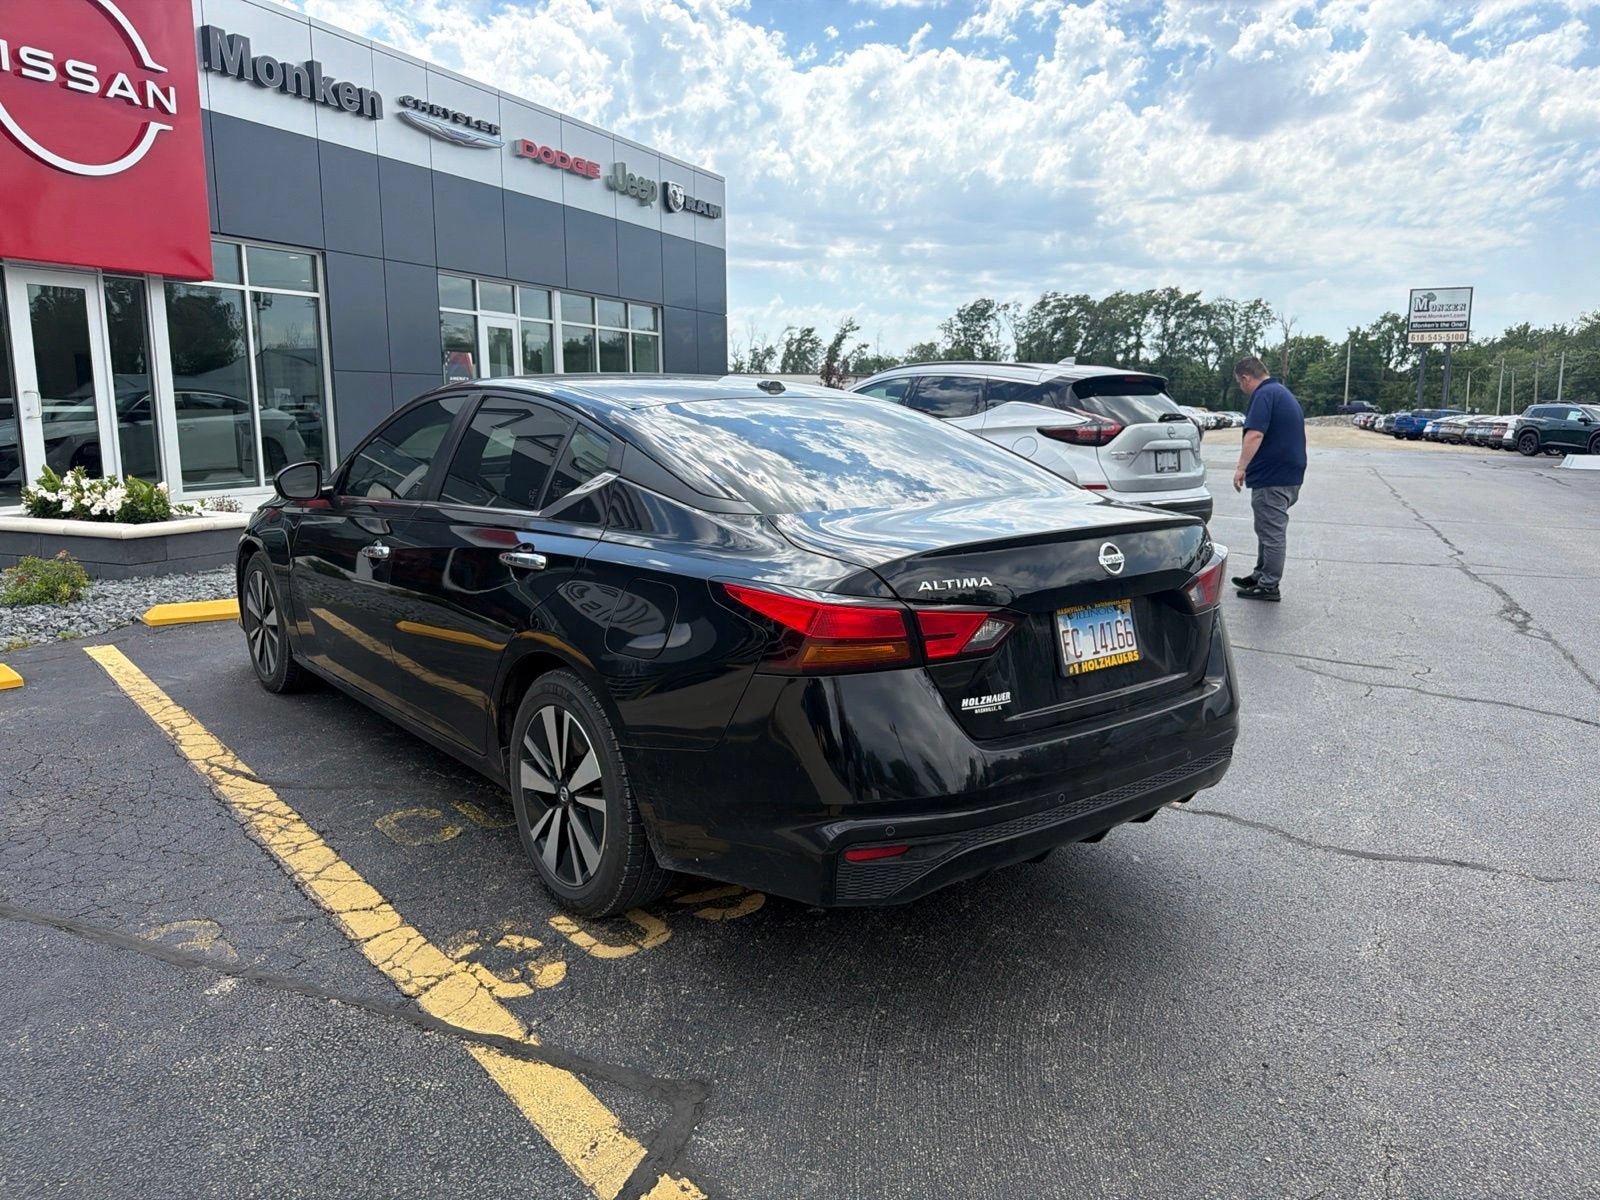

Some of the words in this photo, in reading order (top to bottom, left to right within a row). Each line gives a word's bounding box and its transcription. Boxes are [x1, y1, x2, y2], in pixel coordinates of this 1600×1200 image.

[0, 38, 177, 114] ISSAN
[201, 24, 384, 120] Monken
[399, 95, 501, 135] CHRYSLER
[513, 138, 601, 180] DODGE
[606, 161, 659, 208] Jeep
[684, 194, 722, 219] RAM
[1410, 333, 1465, 342] 618-545-5100
[917, 576, 993, 592] ALTIMA
[1061, 628, 1083, 661] FC
[1088, 618, 1135, 656] 14166
[1069, 664, 1080, 674] #1
[1081, 650, 1140, 673] HOLZHAUERS
[961, 691, 1011, 708] HOLZHAUER
